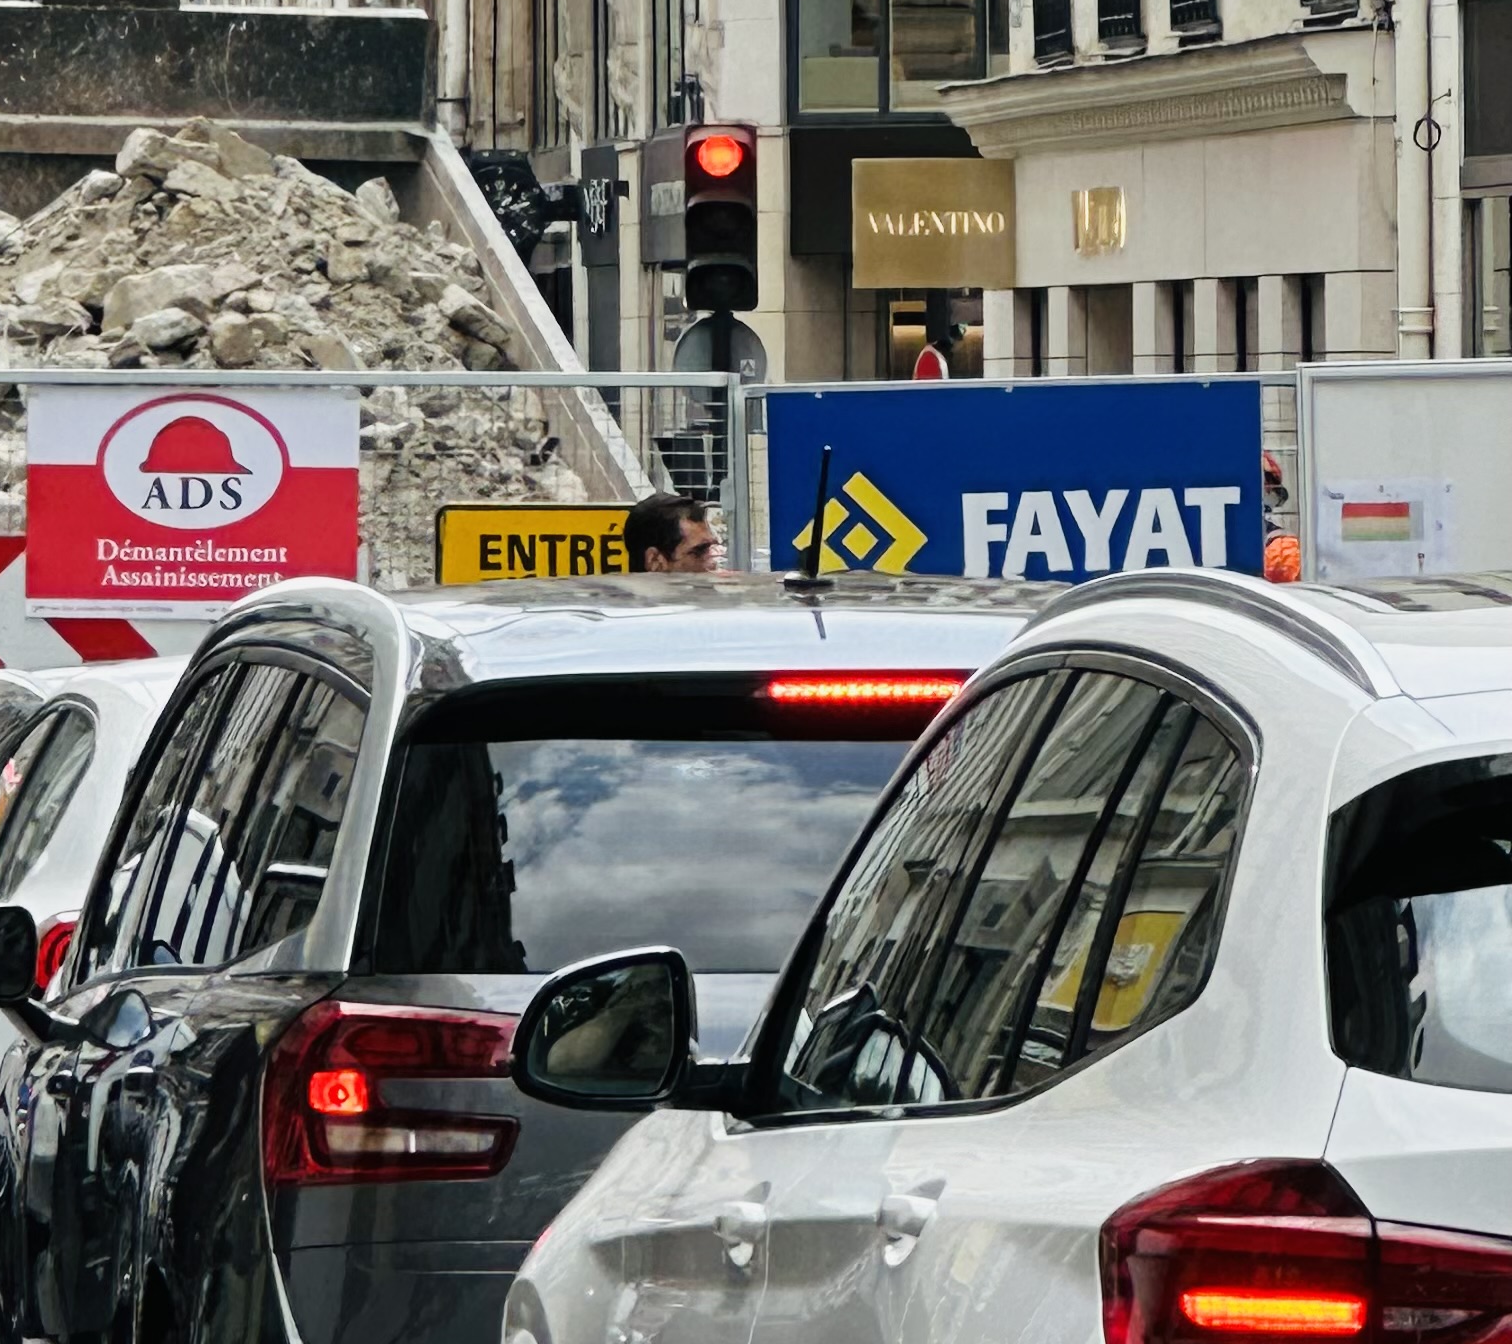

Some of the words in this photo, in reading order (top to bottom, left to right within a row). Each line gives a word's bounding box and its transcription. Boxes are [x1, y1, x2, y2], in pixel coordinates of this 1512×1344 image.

[868, 210, 1006, 236] VALENTINO
[141, 476, 243, 511] ADS
[961, 486, 1241, 581] FAYAT
[97, 538, 288, 563] Démantèlement
